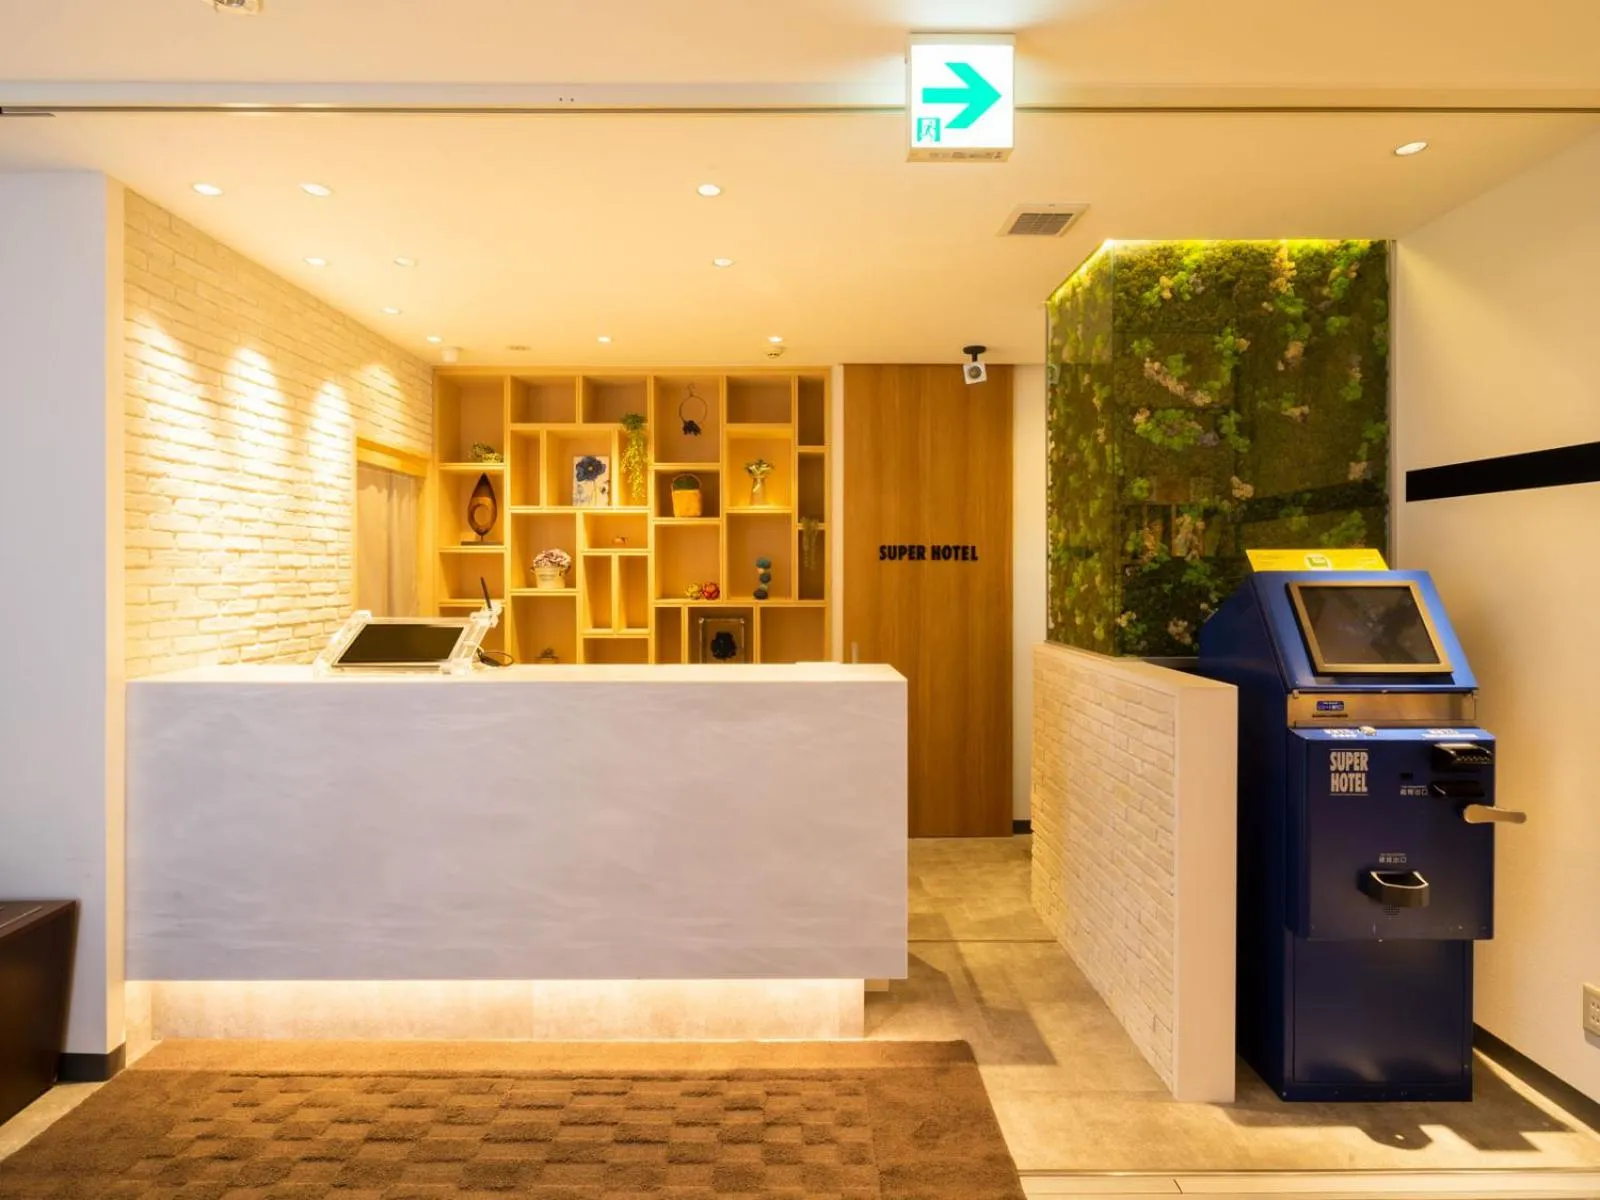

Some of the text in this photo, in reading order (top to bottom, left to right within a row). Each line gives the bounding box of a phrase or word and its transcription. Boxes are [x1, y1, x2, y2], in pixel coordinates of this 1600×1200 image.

[879, 544, 978, 561] SUPER HOTEL
[1329, 751, 1369, 771] SUPER
[1330, 772, 1368, 792] HOTEL
